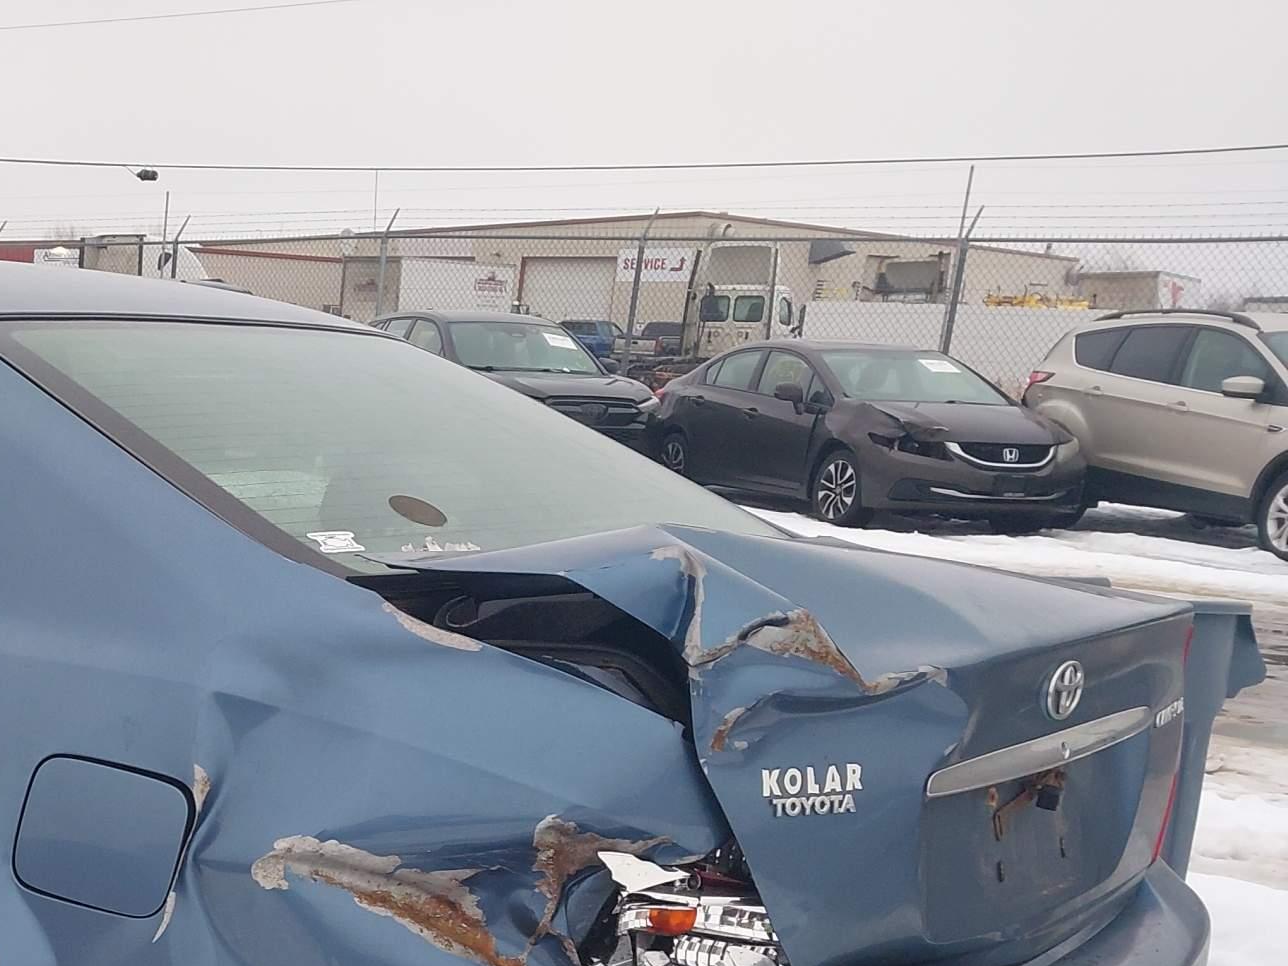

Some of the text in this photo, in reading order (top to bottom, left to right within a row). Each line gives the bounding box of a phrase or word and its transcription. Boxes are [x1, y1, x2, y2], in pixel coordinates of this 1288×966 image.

[623, 257, 667, 270] SEVICE
[761, 763, 863, 797] KOLAR
[772, 794, 856, 817] TOYOTA
